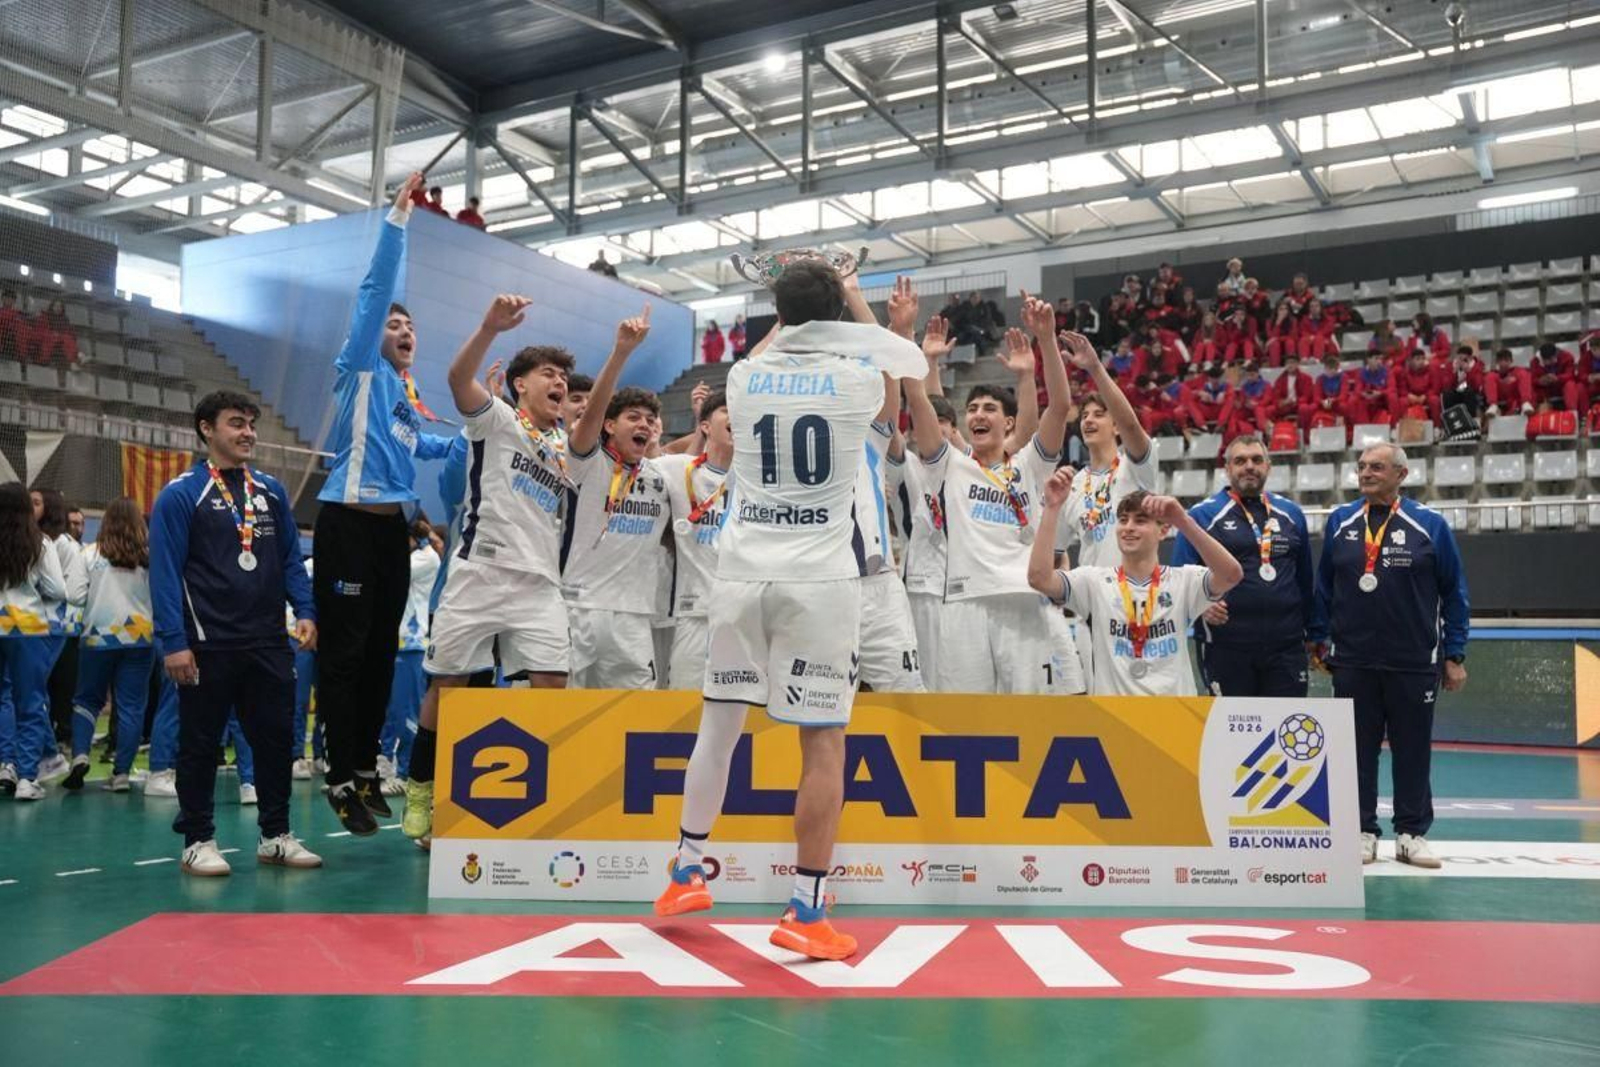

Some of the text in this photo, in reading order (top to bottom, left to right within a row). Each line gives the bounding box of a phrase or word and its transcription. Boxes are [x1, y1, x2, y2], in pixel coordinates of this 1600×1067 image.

[747, 372, 837, 396] GALICIA
[753, 414, 833, 488] 10
[1229, 723, 1262, 733] 2026
[470, 746, 530, 799] 2
[1229, 836, 1332, 849] BALONMANO
[1108, 866, 1150, 876] Diputació
[1191, 868, 1230, 876] Generalitat
[1108, 876, 1150, 884] Barcelona
[1202, 877, 1238, 885] Catalunya
[1264, 872, 1327, 886] esportcat
[997, 885, 1029, 893] Diputació
[404, 922, 1371, 990] AVIS
